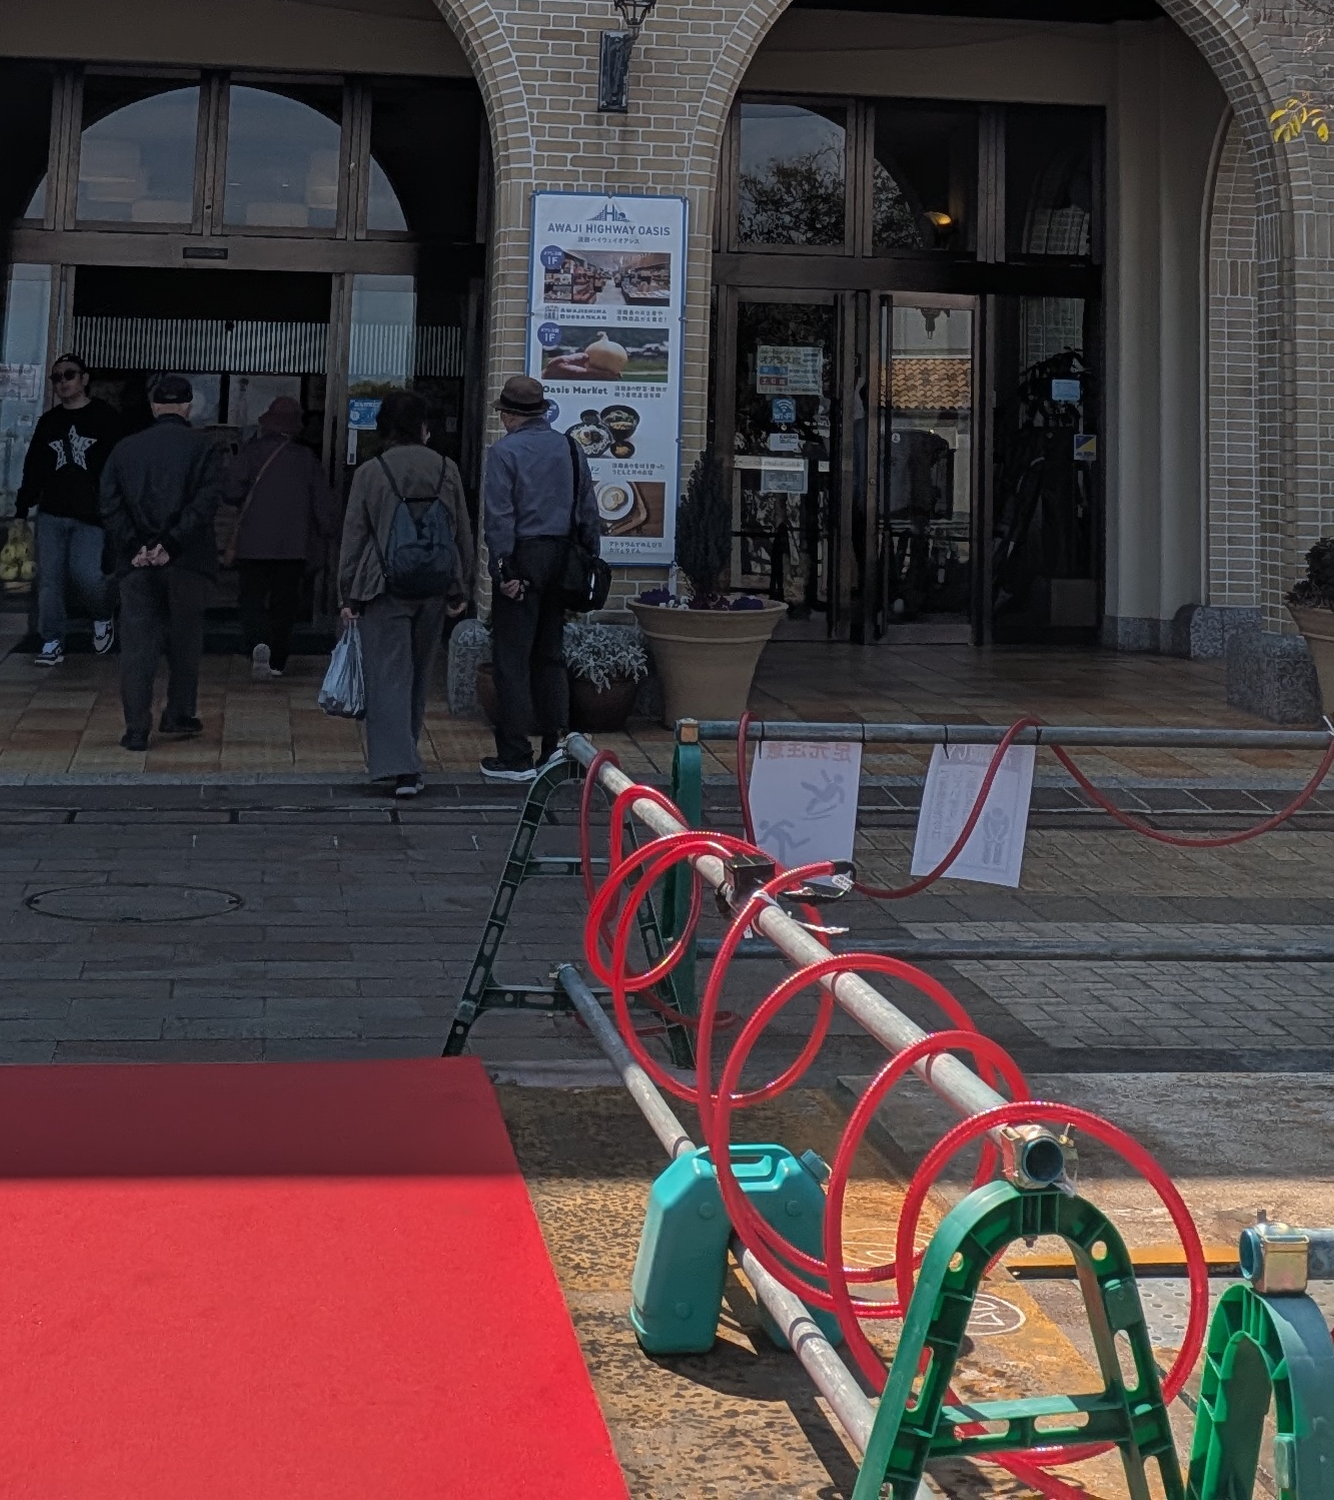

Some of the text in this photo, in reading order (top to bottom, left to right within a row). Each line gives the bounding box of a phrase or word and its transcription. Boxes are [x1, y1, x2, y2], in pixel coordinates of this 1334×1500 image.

[547, 223, 670, 236] AWAJI HIGHWAY OASIS
[547, 256, 558, 265] 1F
[544, 333, 555, 342] 1F
[543, 385, 608, 395] Oasis Market
